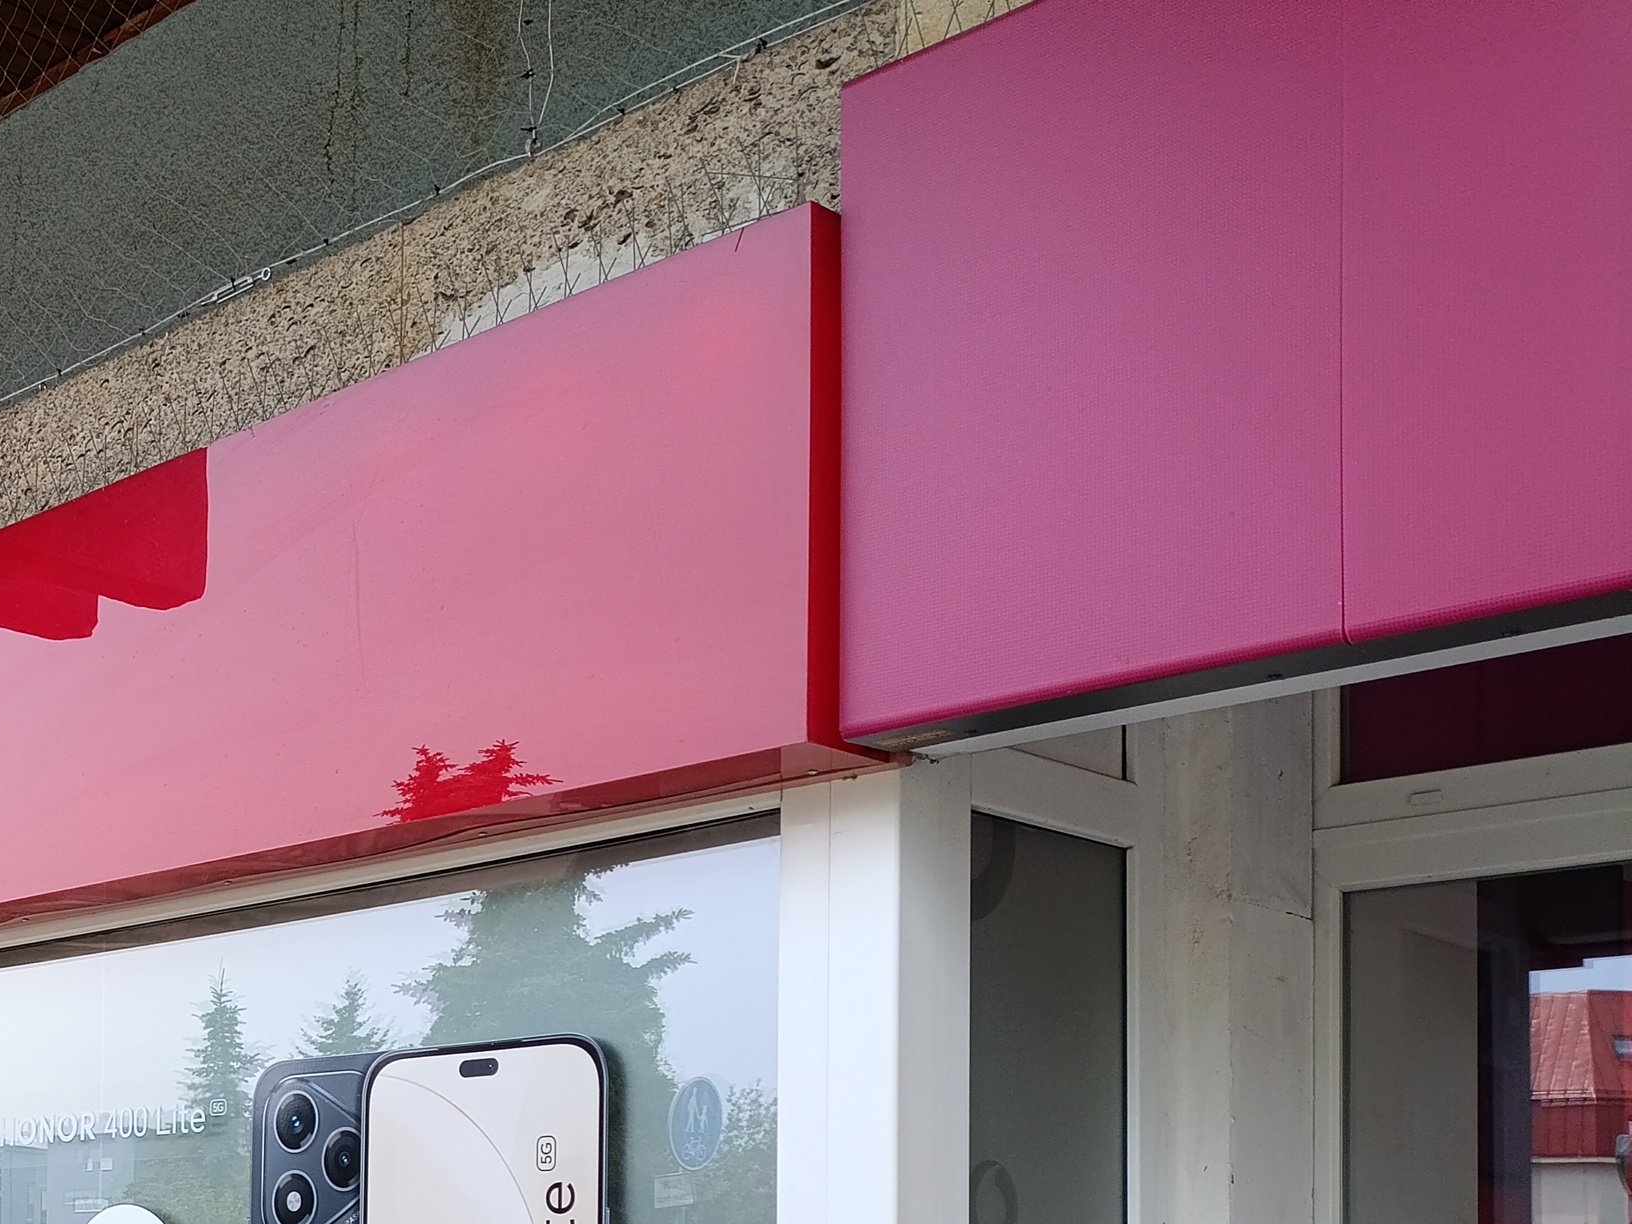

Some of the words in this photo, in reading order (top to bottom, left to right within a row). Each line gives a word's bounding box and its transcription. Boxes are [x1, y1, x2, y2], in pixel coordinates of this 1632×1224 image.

[0, 1110, 96, 1147] HONOR
[104, 1106, 147, 1138] 400
[156, 1103, 207, 1136] Lite
[540, 1141, 552, 1165] 5G
